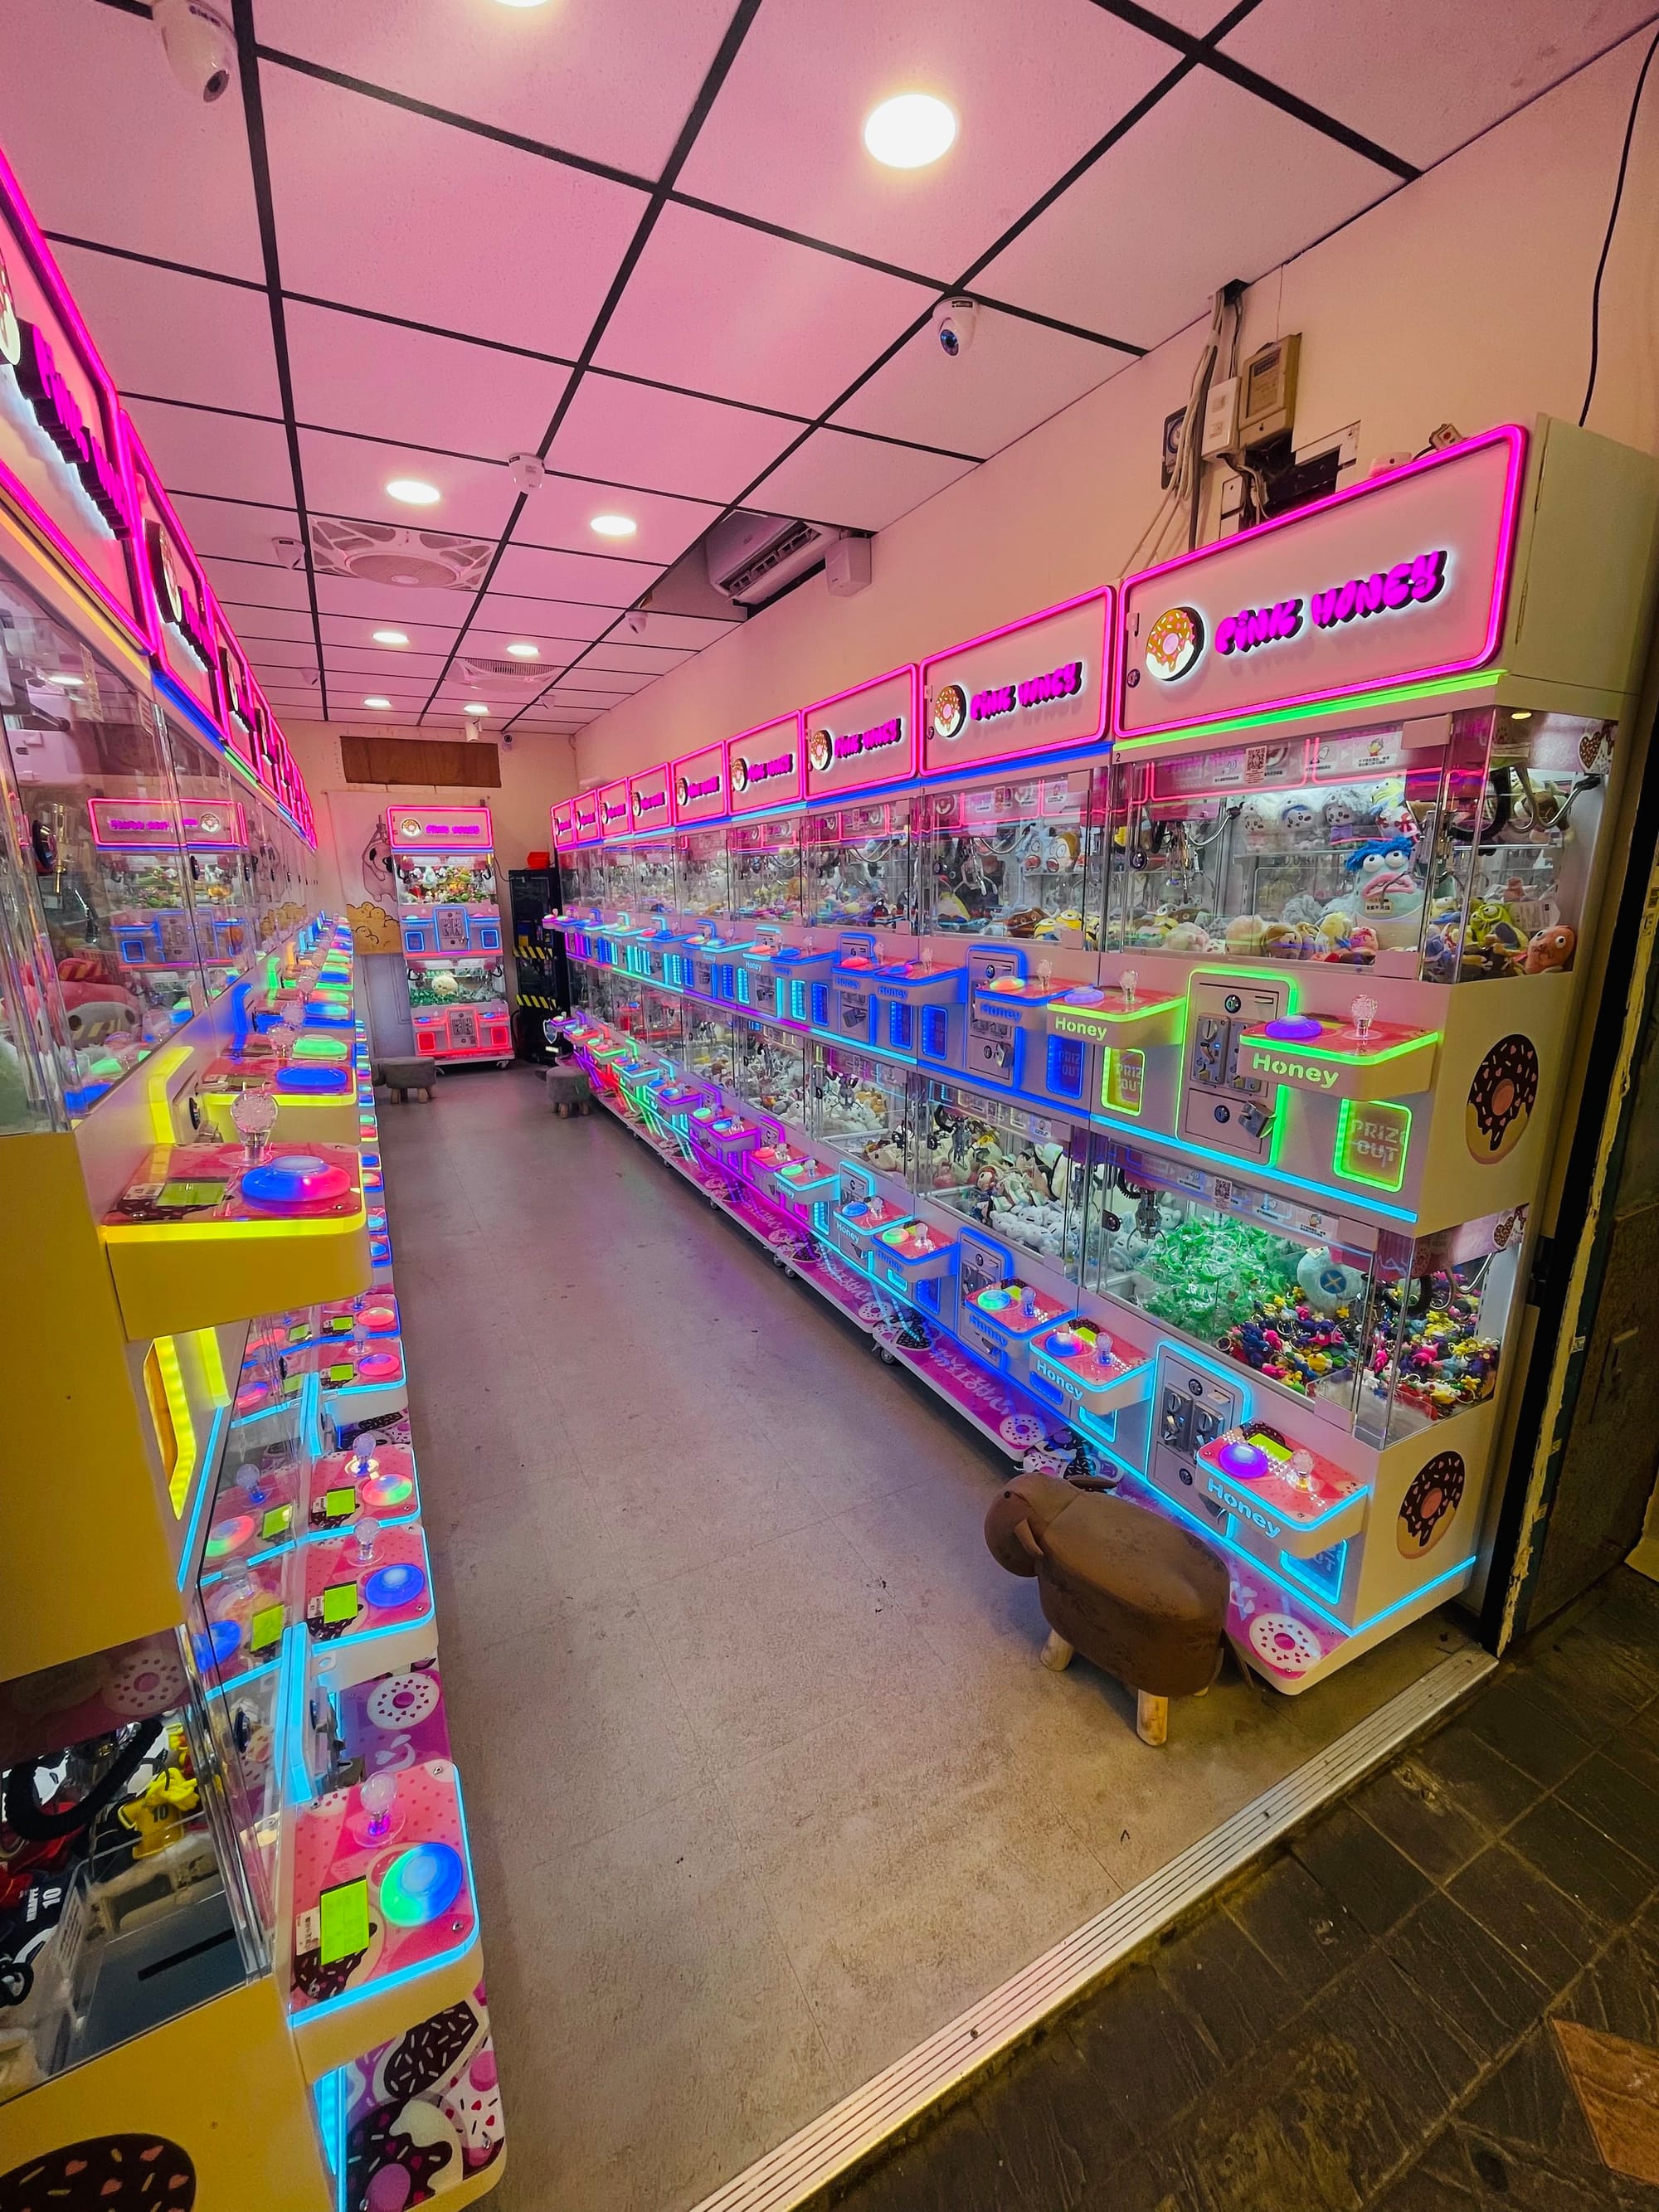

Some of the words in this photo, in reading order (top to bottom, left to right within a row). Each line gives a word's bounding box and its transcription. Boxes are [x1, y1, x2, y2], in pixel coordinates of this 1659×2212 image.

[1215, 599, 1303, 655] PINK
[1311, 551, 1447, 629] HONEY
[1116, 752, 1121, 762] 2
[879, 985, 908, 1000] Honey
[980, 1002, 1022, 1023] Honey
[1055, 1017, 1107, 1042] Honey
[1115, 1062, 1142, 1078] PRIZ
[1253, 1053, 1340, 1089] Honey
[1357, 1140, 1399, 1162] OUT
[837, 1223, 860, 1244] Honey
[970, 1315, 1007, 1349] Honey
[1037, 1359, 1083, 1401] Honey
[1208, 1478, 1281, 1539] Honey
[153, 1804, 169, 1823] 10
[42, 1887, 62, 1909] 10
